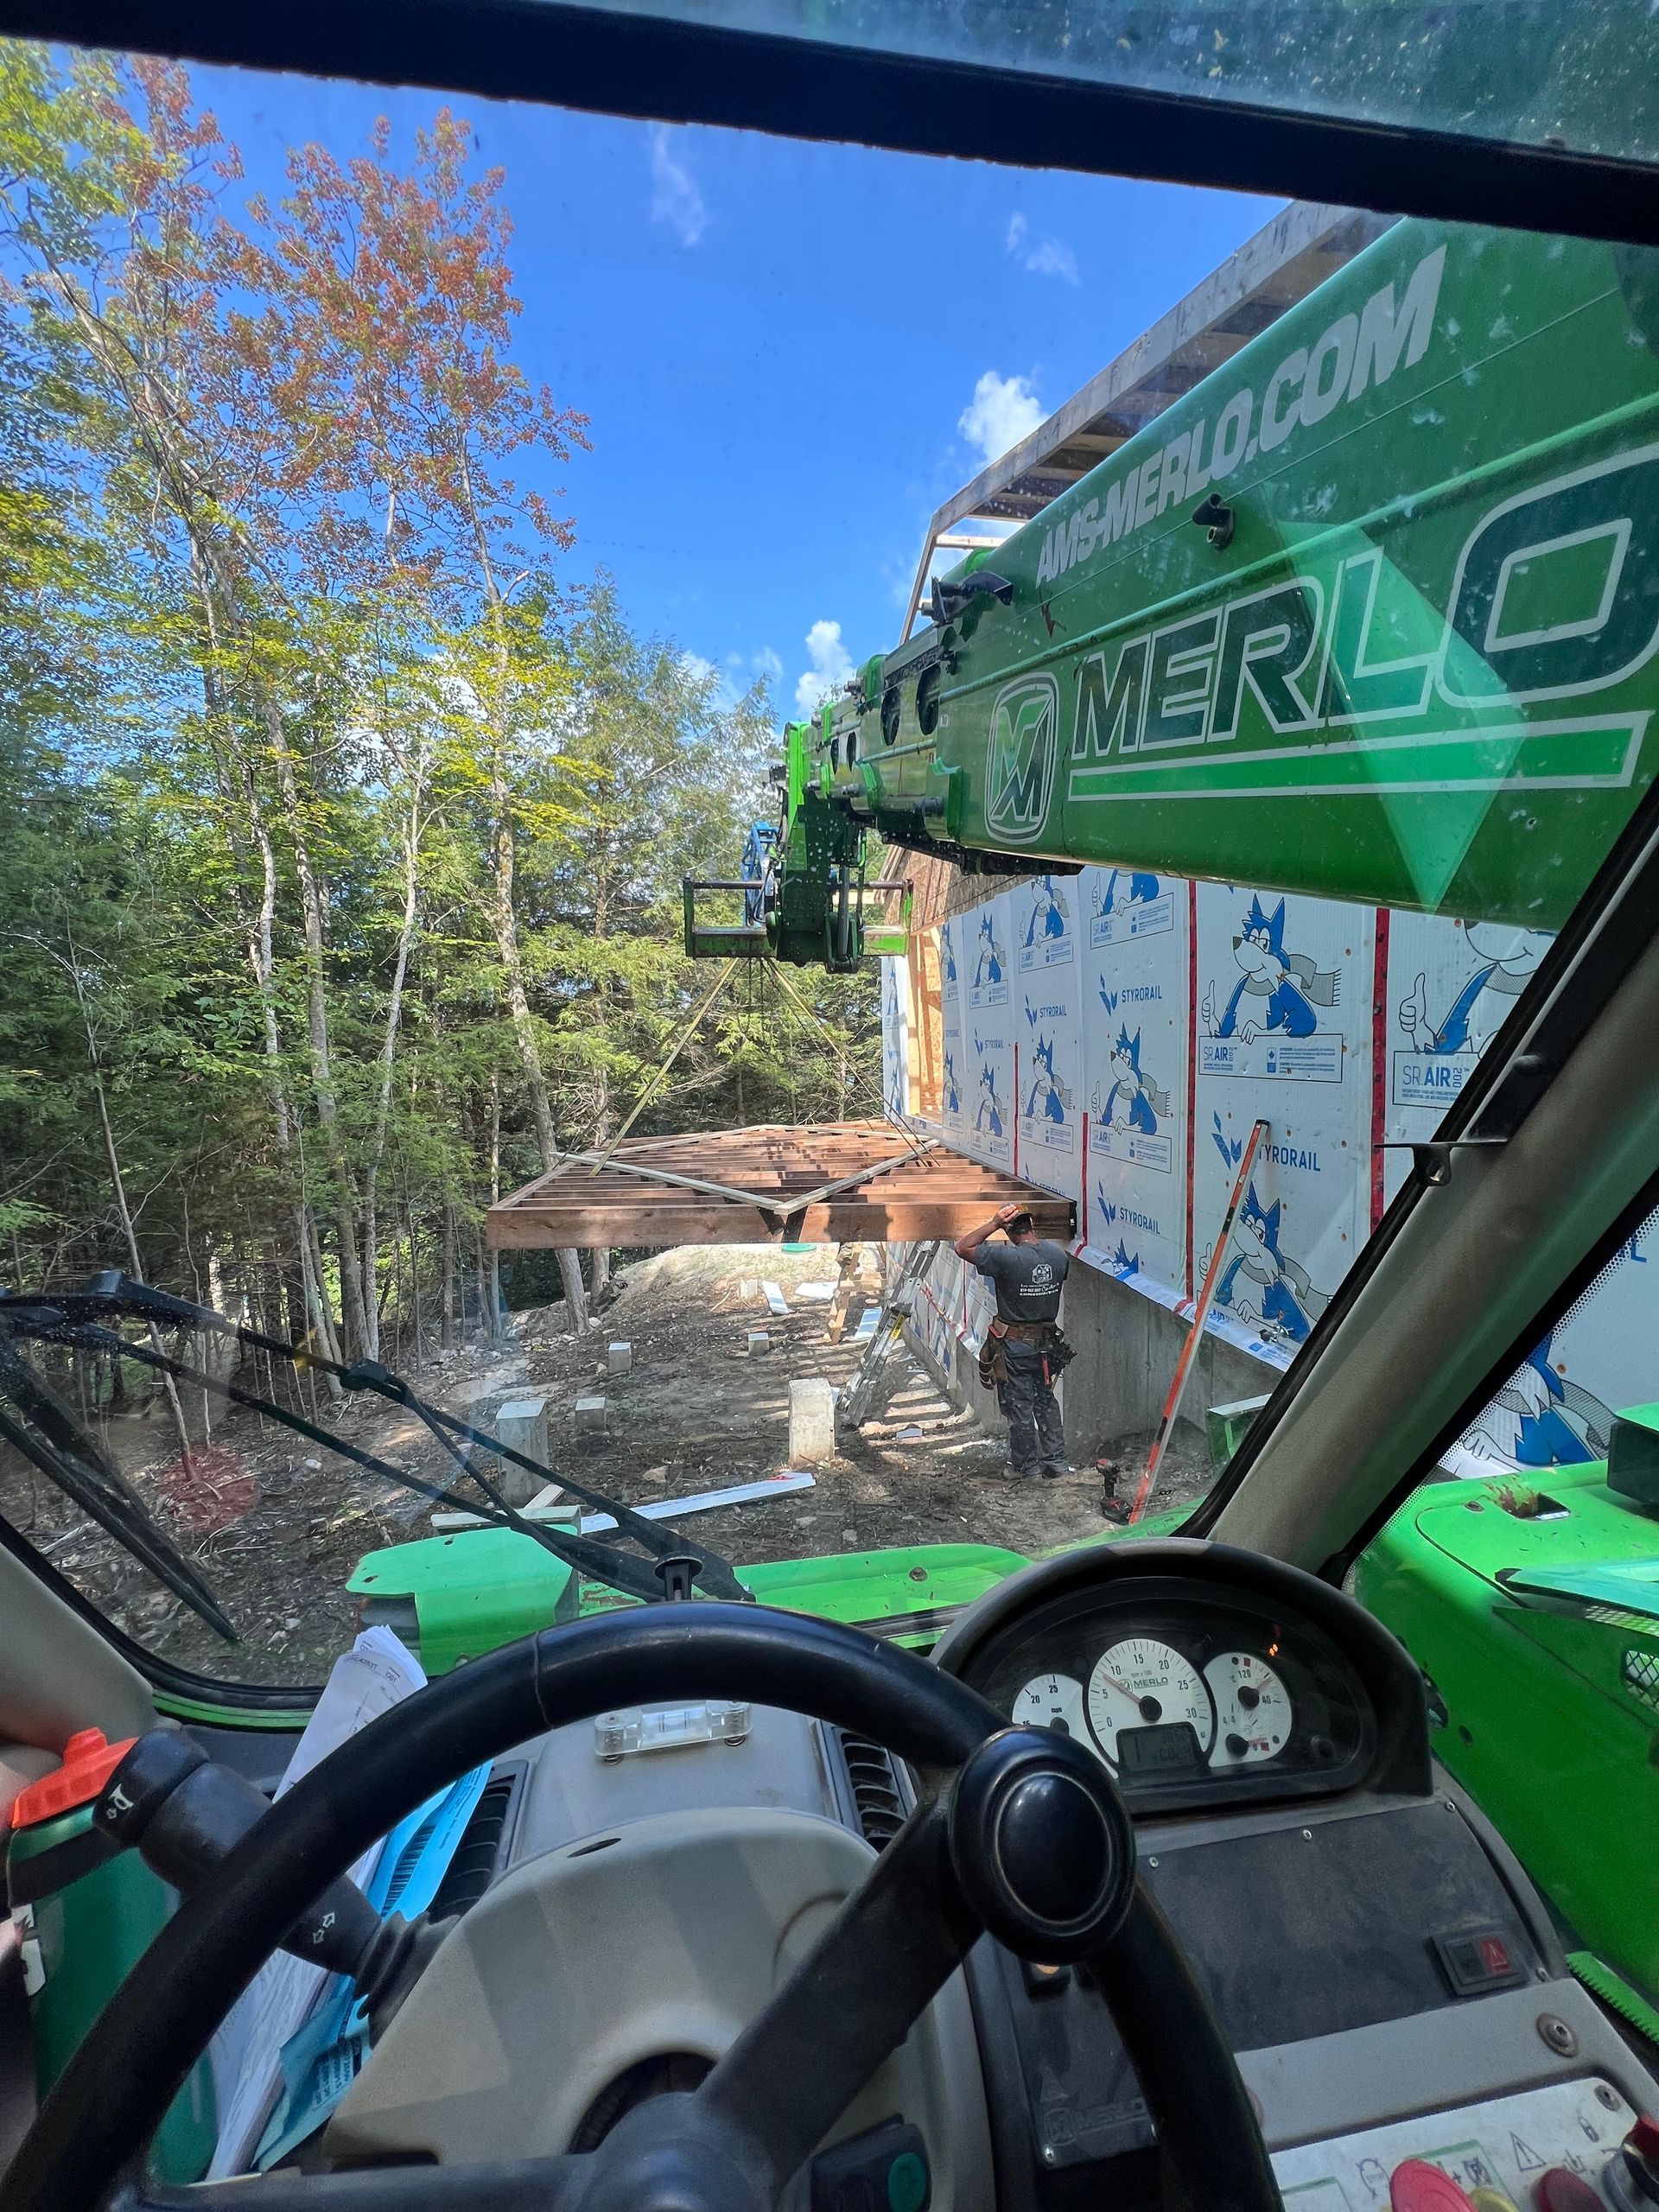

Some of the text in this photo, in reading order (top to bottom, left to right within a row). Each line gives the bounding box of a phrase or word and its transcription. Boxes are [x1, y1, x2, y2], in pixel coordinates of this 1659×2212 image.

[1035, 244, 1447, 590] AMS-MERLO.COM
[1071, 442, 1659, 760] MERLO
[1122, 986, 1162, 1003] STYRORAIL
[1039, 1005, 1067, 1018] STYRORAIL
[1402, 1065, 1451, 1087] SR.AIR
[1452, 1067, 1462, 1088] 200
[1120, 1207, 1160, 1234] STYRORAIL
[1134, 1654, 1144, 1664] 15
[1159, 1659, 1170, 1670] 20
[1110, 1665, 1122, 1675] 10
[1238, 1669, 1251, 1679] 120
[1134, 1676, 1168, 1688] MERLO
[1178, 1680, 1189, 1690] 25
[1048, 1684, 1058, 1694] 25
[1103, 1688, 1109, 1699] 5
[1031, 1694, 1040, 1704] 20
[1262, 1695, 1272, 1705] 40
[1185, 1707, 1197, 1719] 30
[1106, 1716, 1113, 1727] 0
